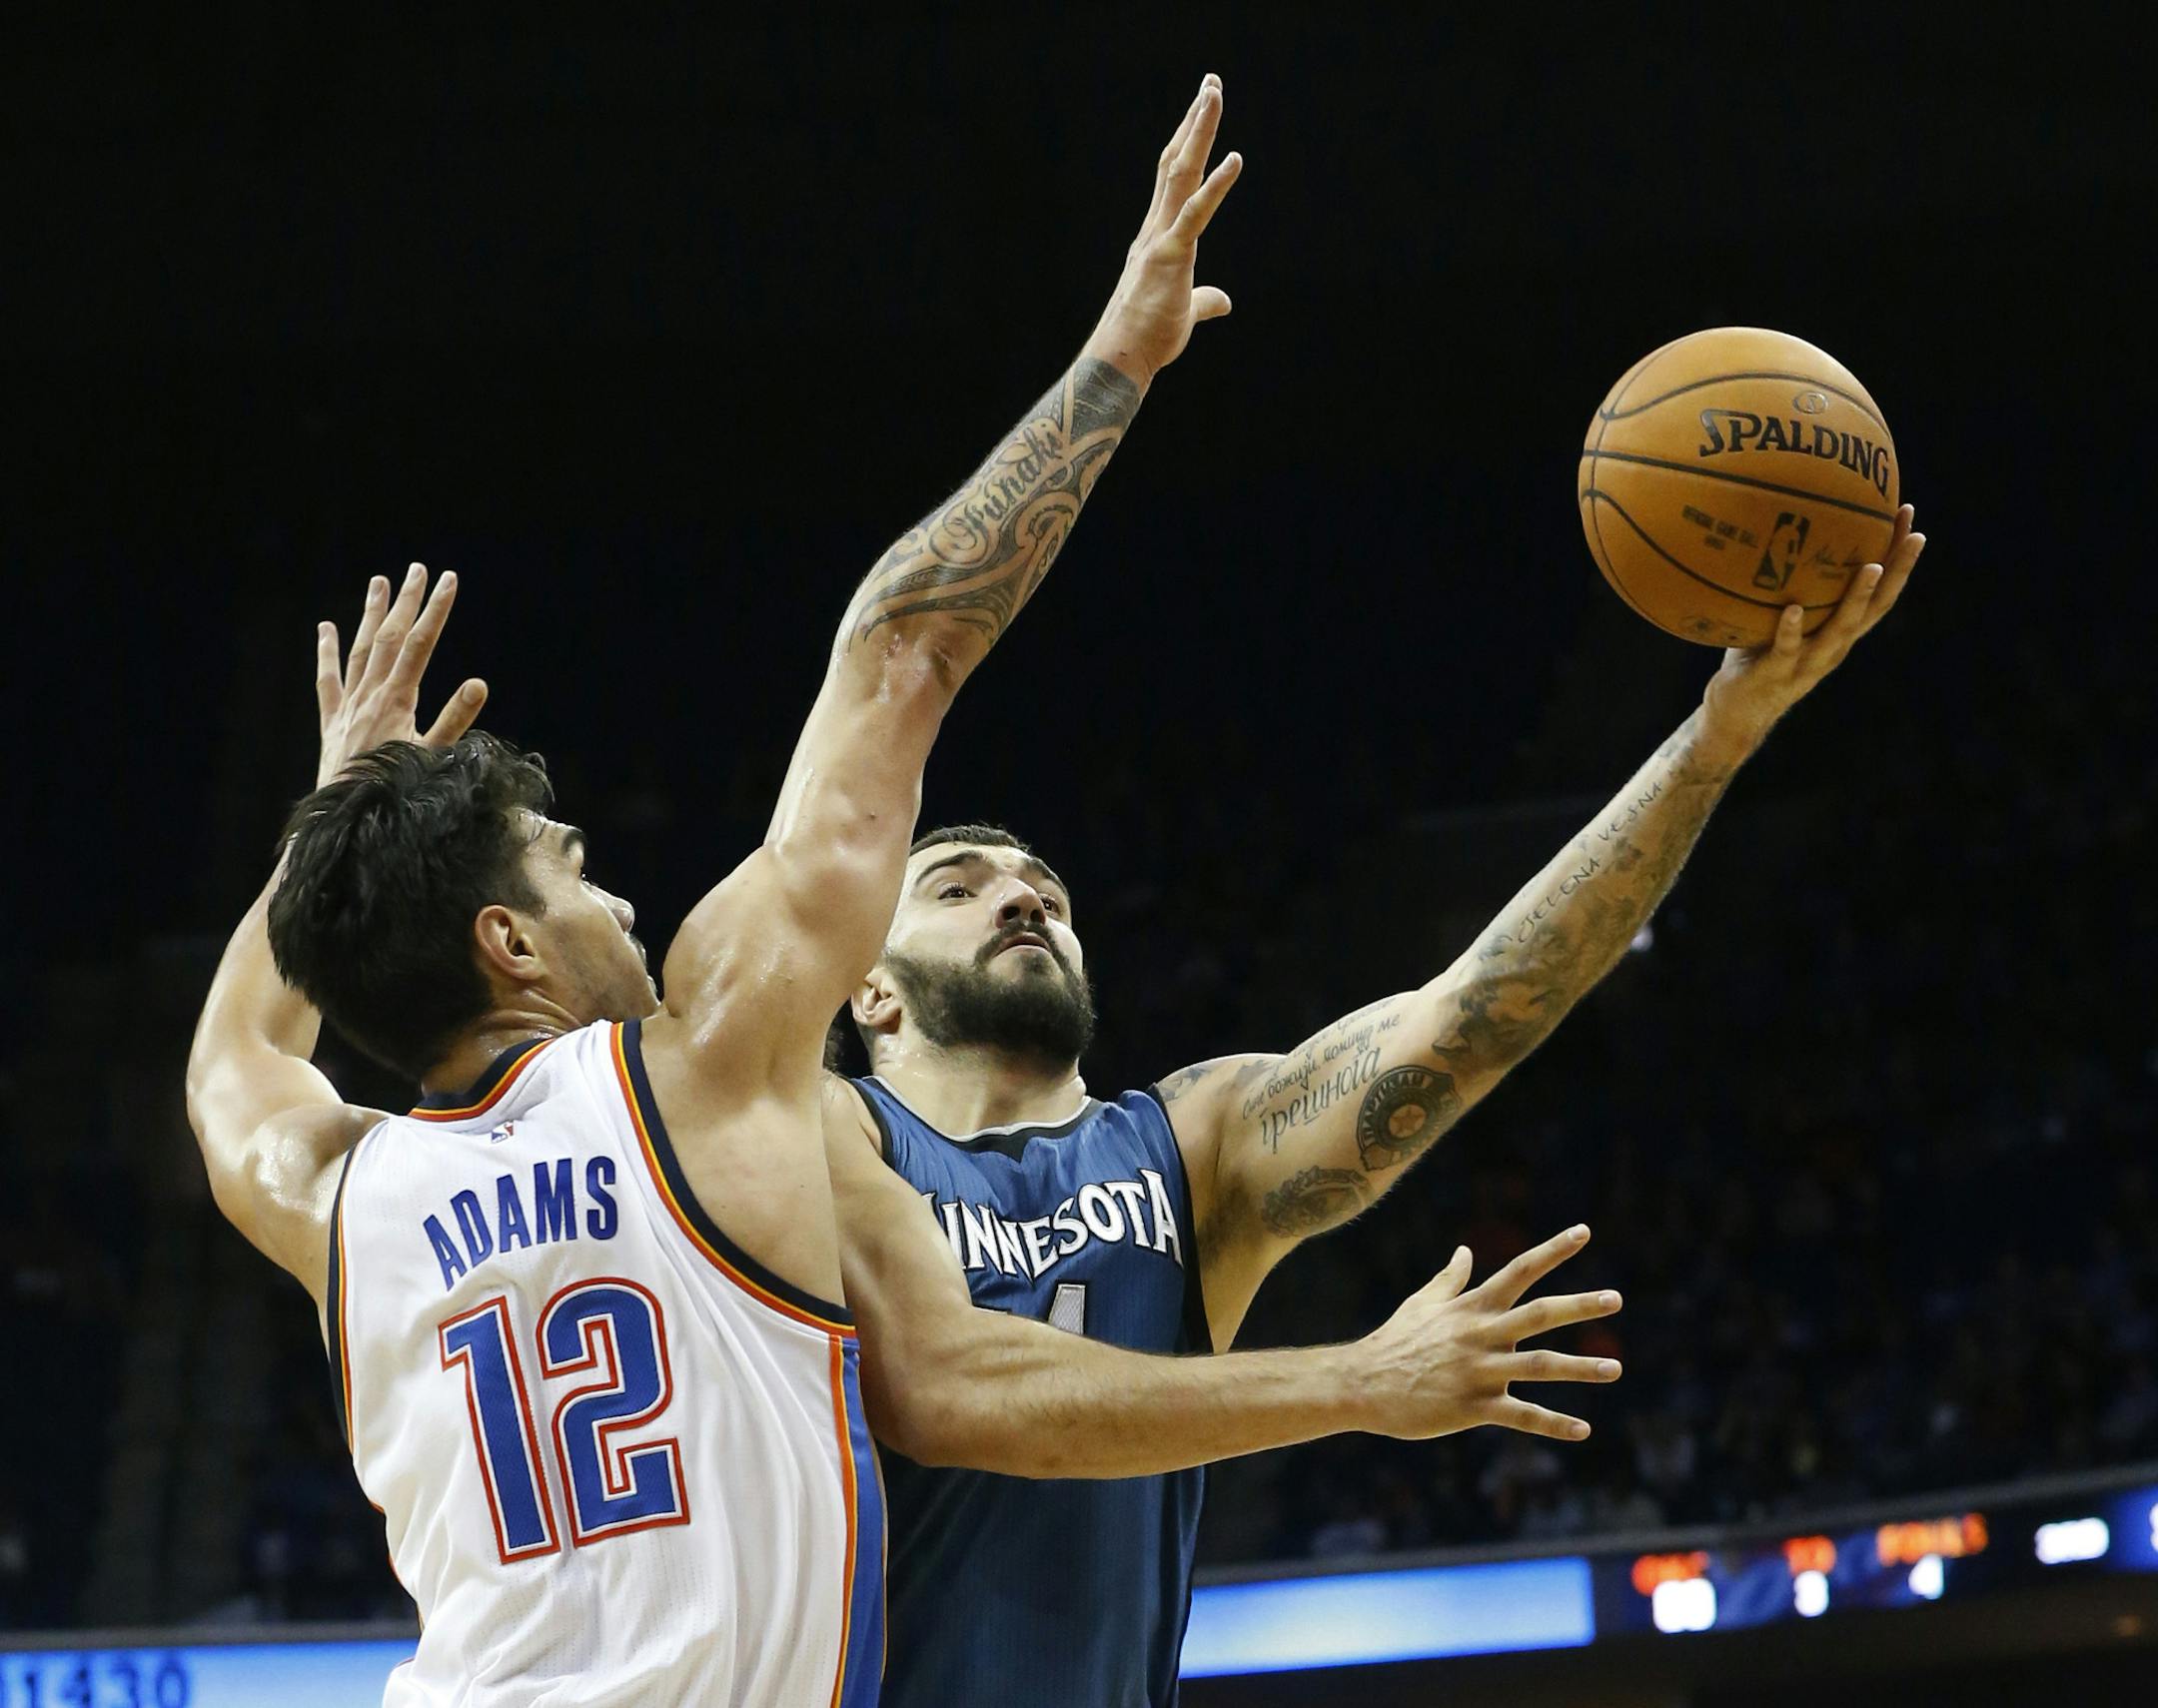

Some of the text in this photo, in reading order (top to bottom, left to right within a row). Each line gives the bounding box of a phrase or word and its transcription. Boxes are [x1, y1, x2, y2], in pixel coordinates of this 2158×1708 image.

[1699, 409, 1889, 497] SPALDING
[423, 1156, 617, 1291] ADAMS
[921, 1167, 1185, 1284] INNESOTA
[438, 1277, 690, 1565] 12
